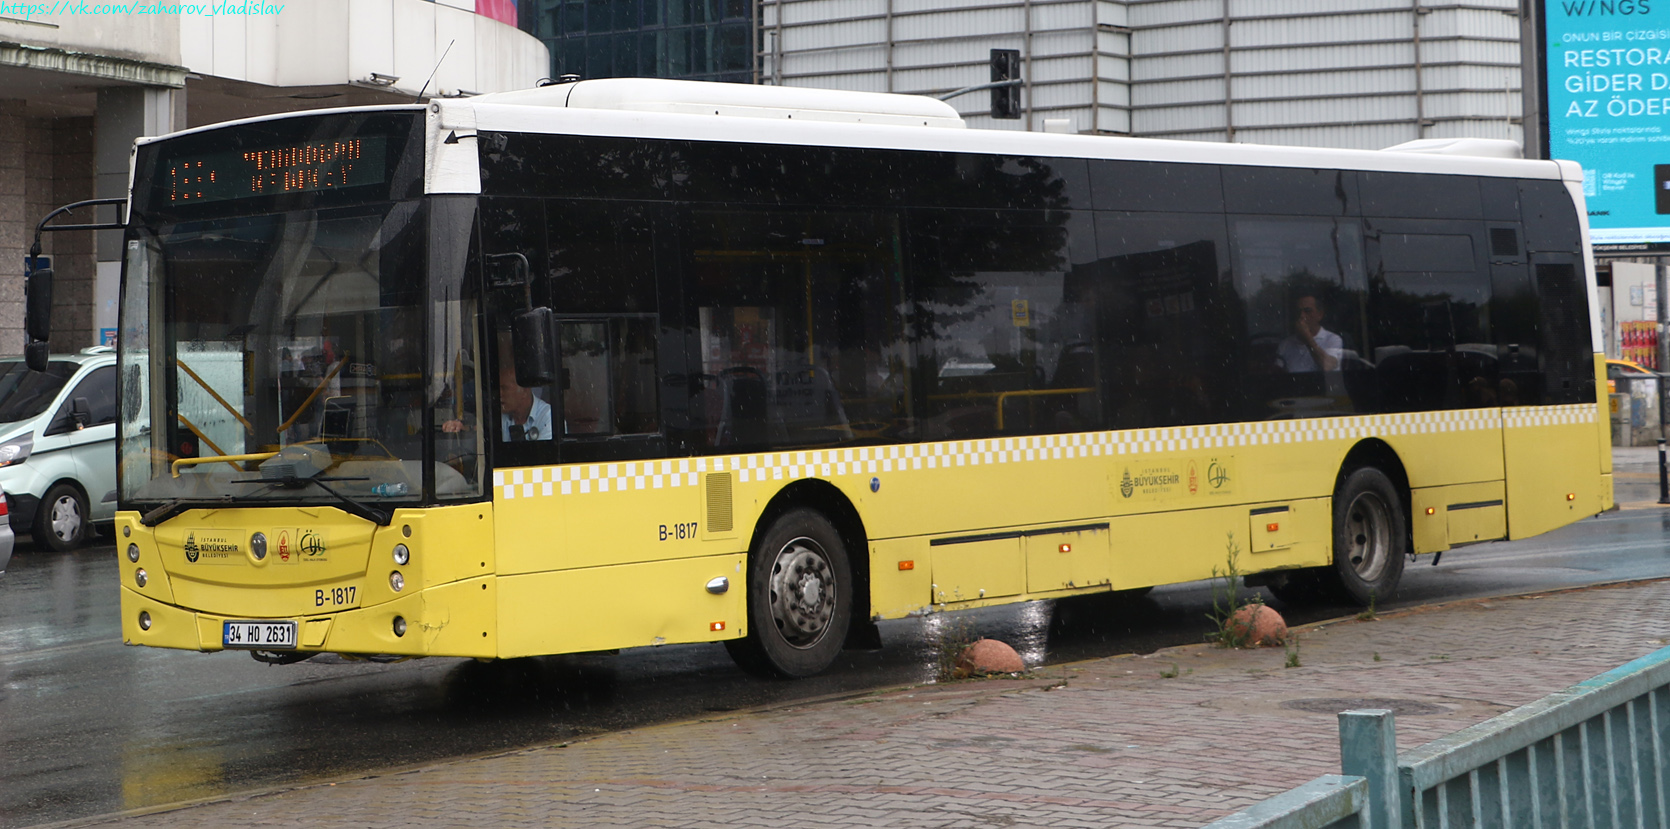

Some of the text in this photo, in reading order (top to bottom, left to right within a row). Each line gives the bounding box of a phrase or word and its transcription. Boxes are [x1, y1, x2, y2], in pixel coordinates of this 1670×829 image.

[1562, 32, 1600, 43] ONUN
[1602, 29, 1623, 42] BİR
[1564, 71, 1670, 93] GİDER D
[1565, 100, 1599, 118] AZ
[659, 522, 698, 541] B-1817
[200, 543, 239, 552] BÜYÜKŞEHİR
[315, 586, 356, 606] B-1817
[230, 625, 241, 642] 34
[266, 625, 291, 643] 2631
